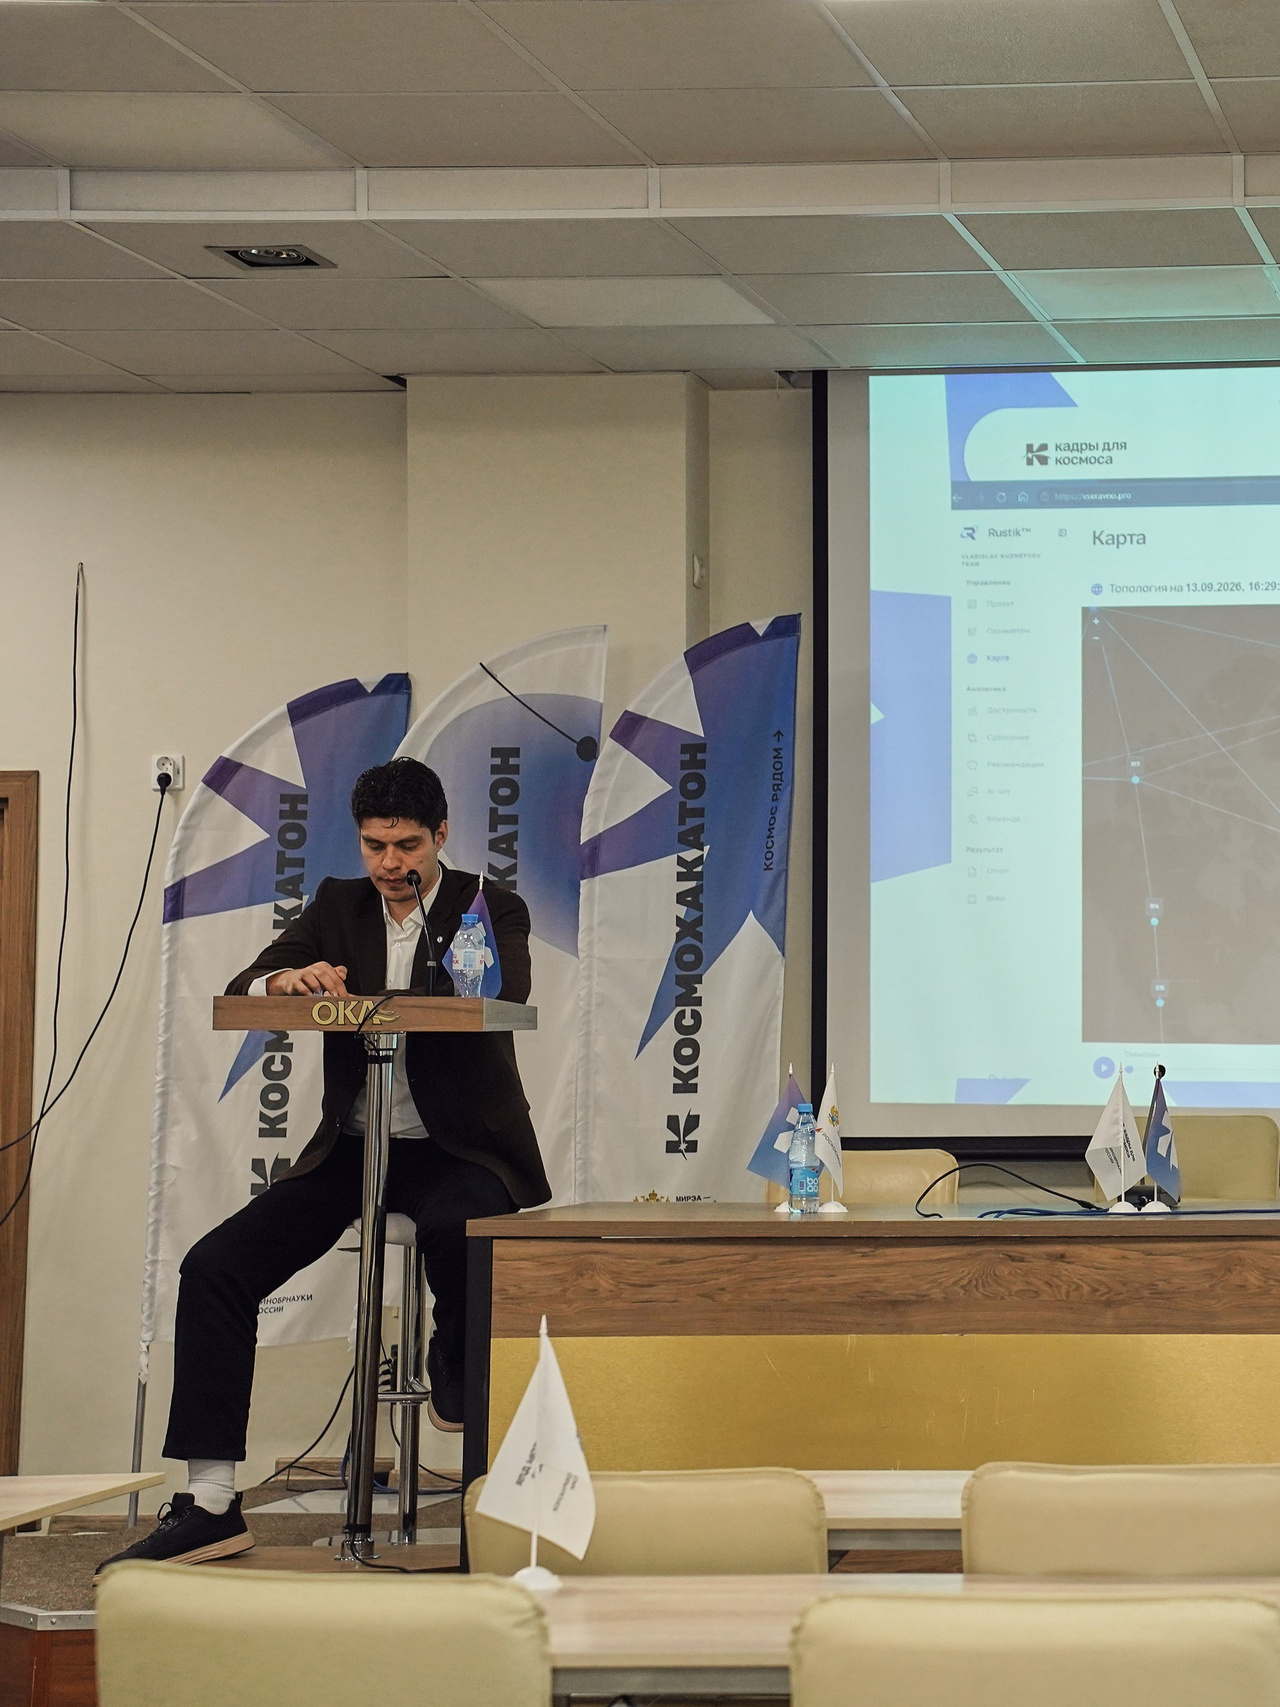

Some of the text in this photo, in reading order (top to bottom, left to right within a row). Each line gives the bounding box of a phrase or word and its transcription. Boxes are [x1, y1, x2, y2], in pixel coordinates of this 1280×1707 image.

[1055, 441, 1127, 453] кадры для
[1055, 455, 1113, 466] космоса
[1091, 530, 1147, 549] Карта
[1108, 584, 1168, 594] Топология
[1169, 585, 1183, 593] на
[1186, 581, 1245, 593] 13.09.2026,
[986, 654, 1010, 662] Карта
[763, 747, 784, 871] КОСМОС РЯДОМ
[672, 742, 707, 1094] КОСМОХАКАТОН
[675, 1195, 702, 1203] МИРЭА
[260, 1293, 313, 1305] ИНОБРНАУКИ
[260, 1306, 284, 1314] ОССИИ
